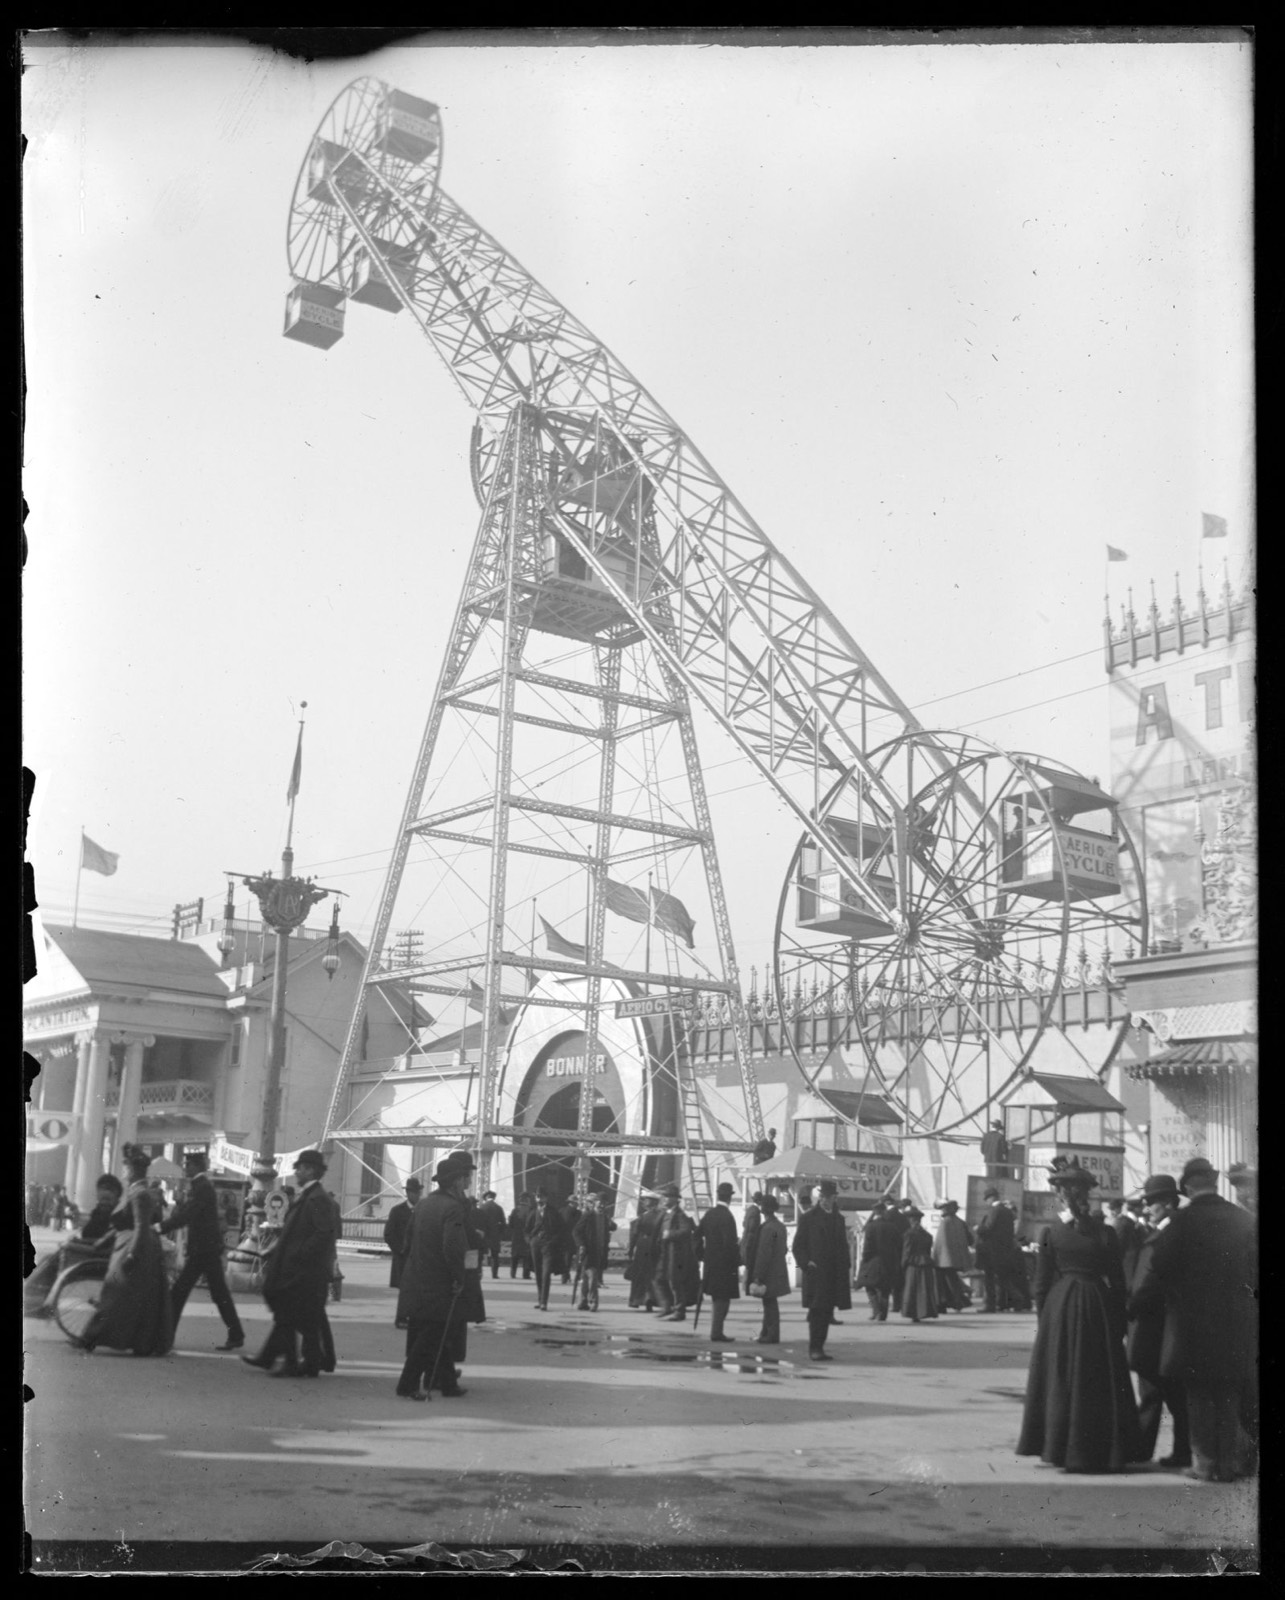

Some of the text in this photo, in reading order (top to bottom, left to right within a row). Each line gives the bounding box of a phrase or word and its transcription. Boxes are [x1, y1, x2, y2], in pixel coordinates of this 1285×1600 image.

[1066, 836, 1105, 857] AERIO
[618, 1000, 653, 1017] AERIO
[849, 1160, 890, 1177] AERIO
